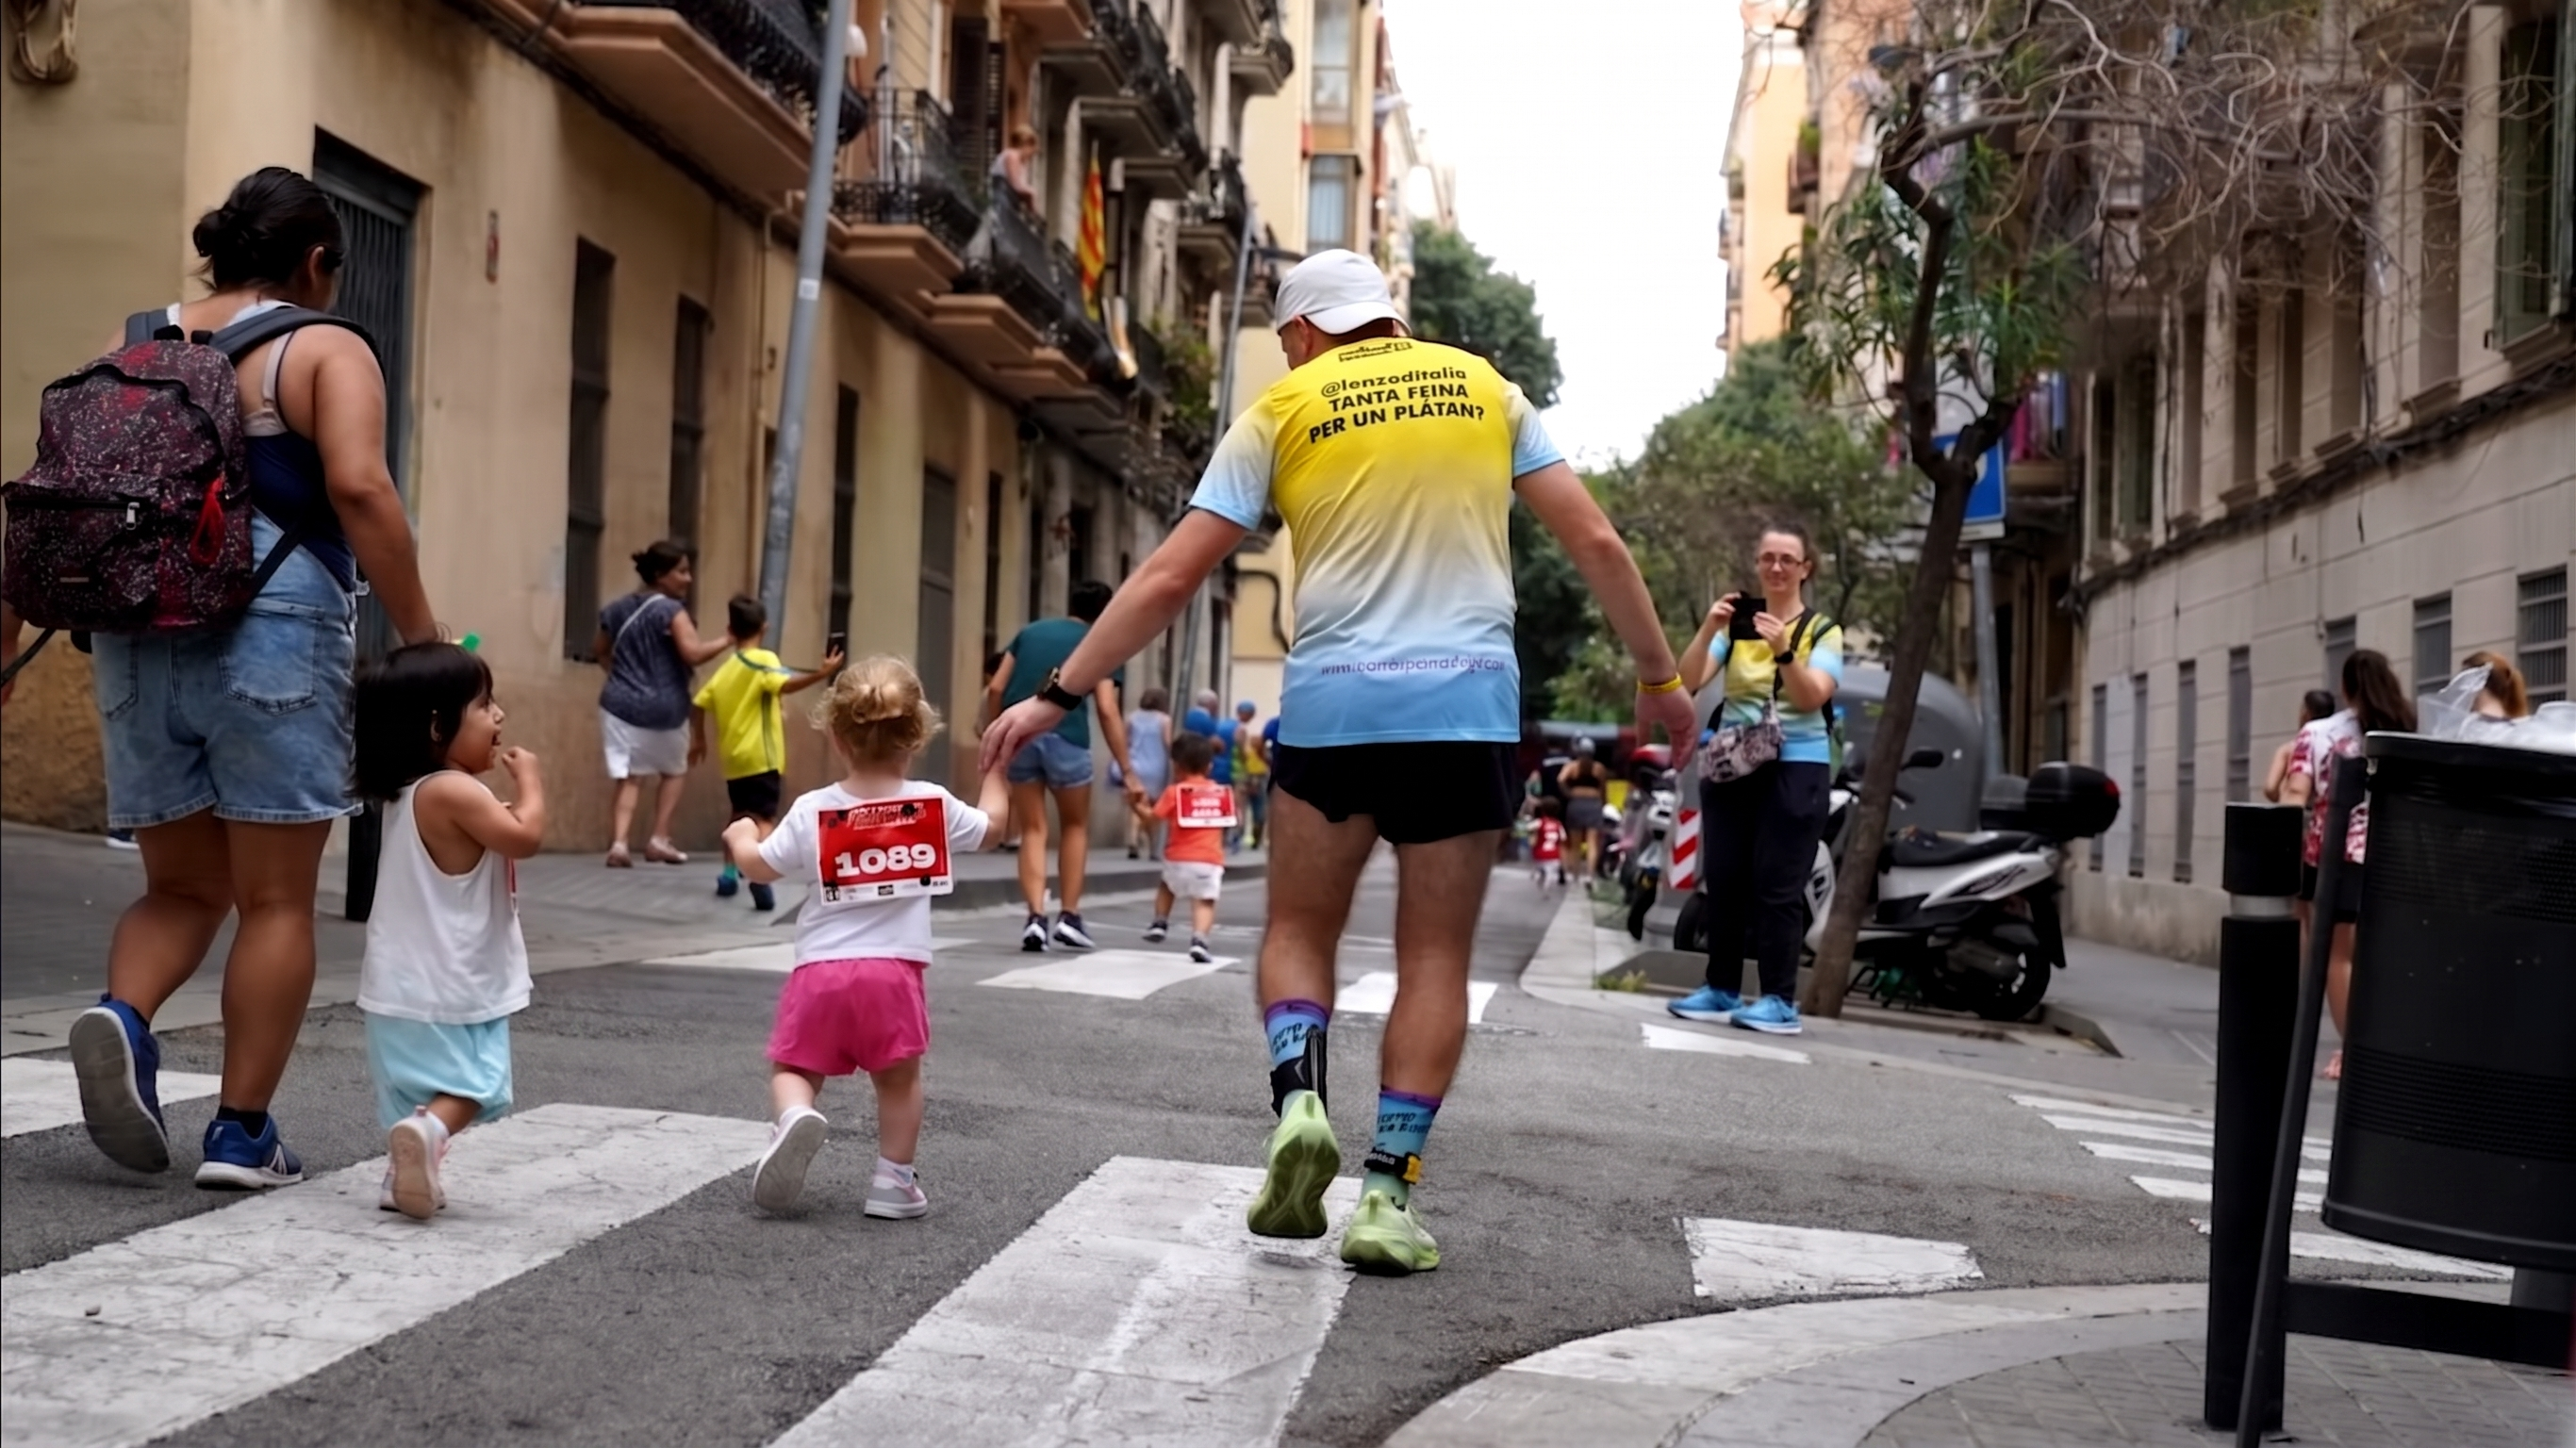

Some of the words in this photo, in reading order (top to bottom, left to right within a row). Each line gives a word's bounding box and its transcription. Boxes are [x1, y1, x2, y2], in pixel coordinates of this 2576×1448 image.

[1321, 367, 1467, 398] @lenzoditalia
[1329, 388, 1400, 413] TANTA
[1408, 384, 1469, 400] FEINA
[1309, 416, 1346, 444] PER
[1353, 409, 1387, 428] UN
[1394, 400, 1485, 422] PLÁTAN?
[834, 843, 936, 878] 1089
